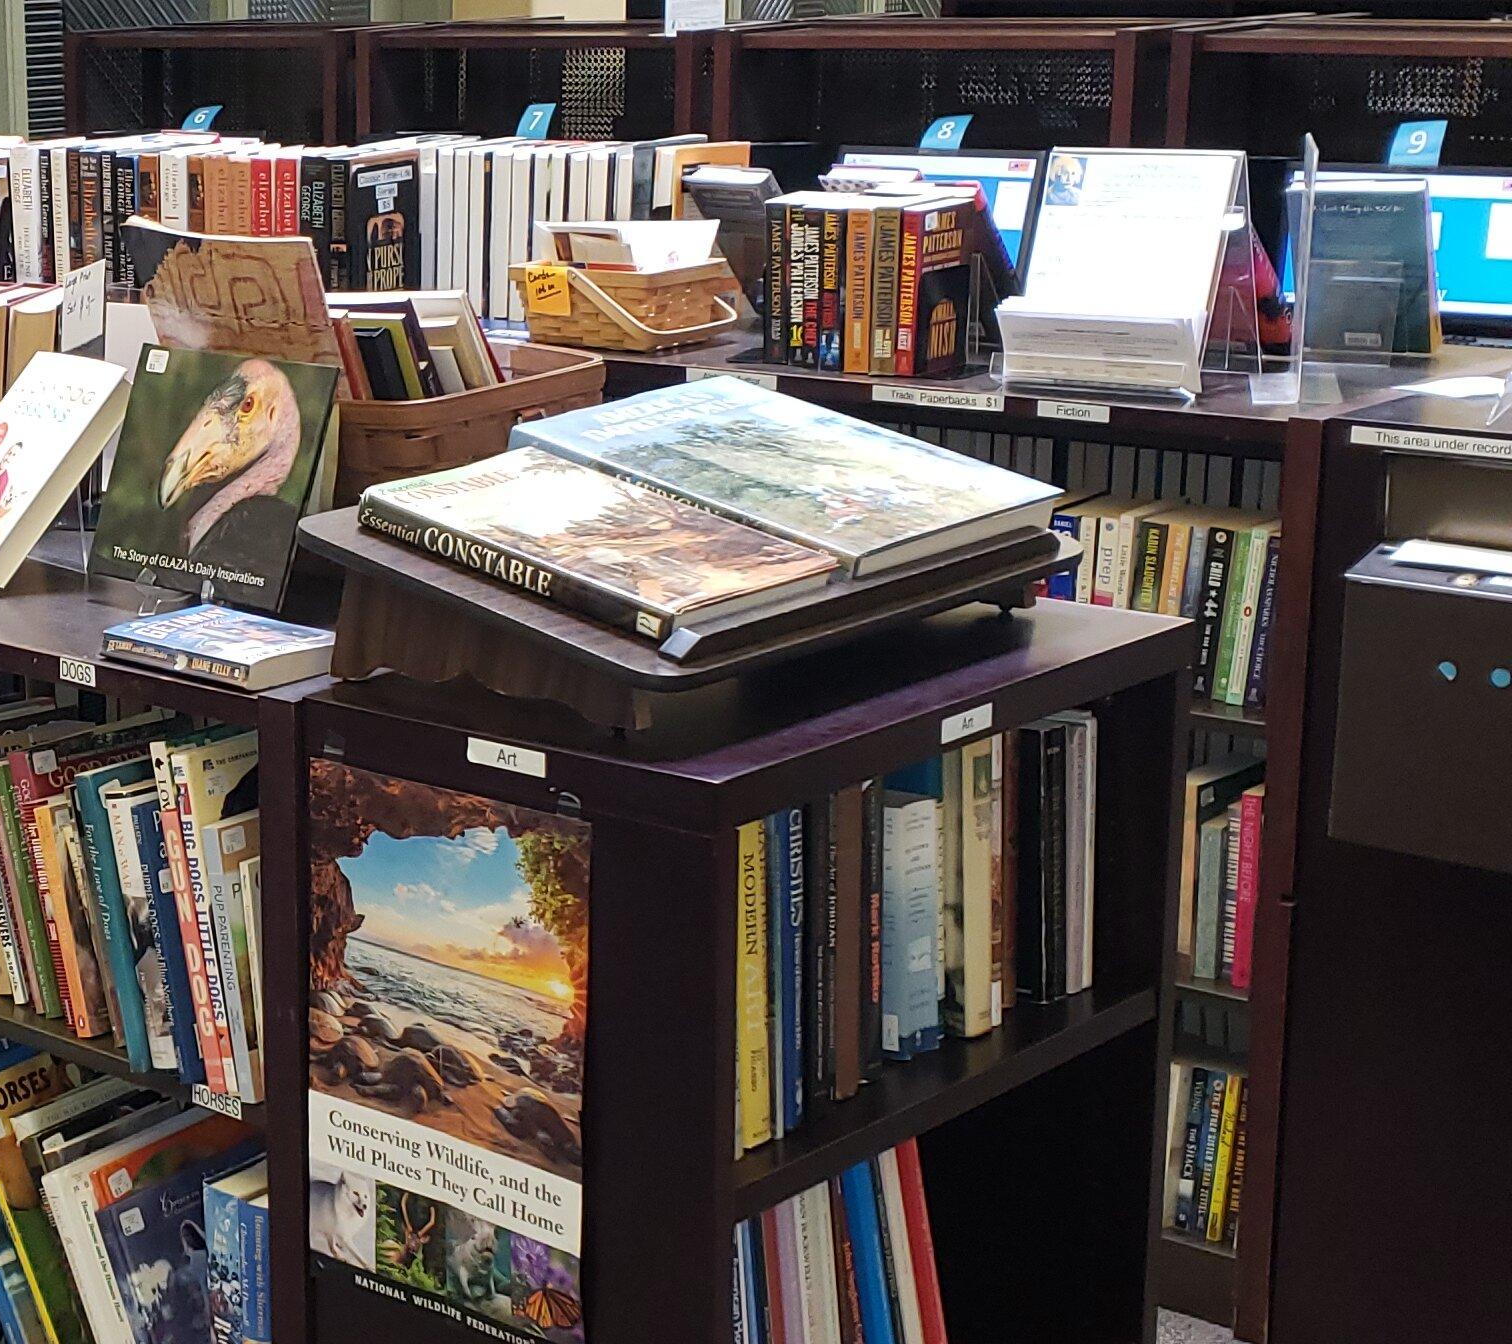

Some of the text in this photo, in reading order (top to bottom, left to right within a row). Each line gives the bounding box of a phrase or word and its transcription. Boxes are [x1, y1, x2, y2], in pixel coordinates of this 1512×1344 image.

[194, 110, 206, 124] 6
[528, 111, 544, 131] 7
[937, 121, 953, 139] 8
[1409, 130, 1428, 154] 9
[301, 185, 311, 221] GEORGE
[312, 181, 325, 228] ELIZABETH
[923, 229, 963, 254] PATTERSON
[852, 232, 866, 320] JAMES PATTERSON
[899, 233, 917, 326] JAMES PATTERSON
[891, 389, 998, 407] Trade Paperbacks $1
[1056, 405, 1090, 419] Fiction
[1376, 431, 1400, 444] This
[1403, 436, 1430, 447] area
[1434, 438, 1469, 451] under
[113, 545, 265, 587] The Story of GLAZA's Daily Inspirations
[361, 508, 552, 597] Essential CONSTABLE
[1099, 546, 1113, 585] prep
[63, 662, 92, 683] DOGS
[497, 749, 517, 766] Art
[181, 820, 225, 1021] BIG DOGS LITTLE DOGS
[743, 853, 758, 956] MODERN
[167, 827, 214, 1038] GUN DOG
[214, 885, 236, 992] PUP PARENTING
[192, 1086, 240, 1117] HORSES
[329, 1109, 562, 1207] Conserving Wildlife, and the
[327, 1134, 565, 1235] Wild Places They Call Home
[354, 1274, 407, 1302] NATIONAL
[412, 1295, 462, 1321] WILDLIFE
